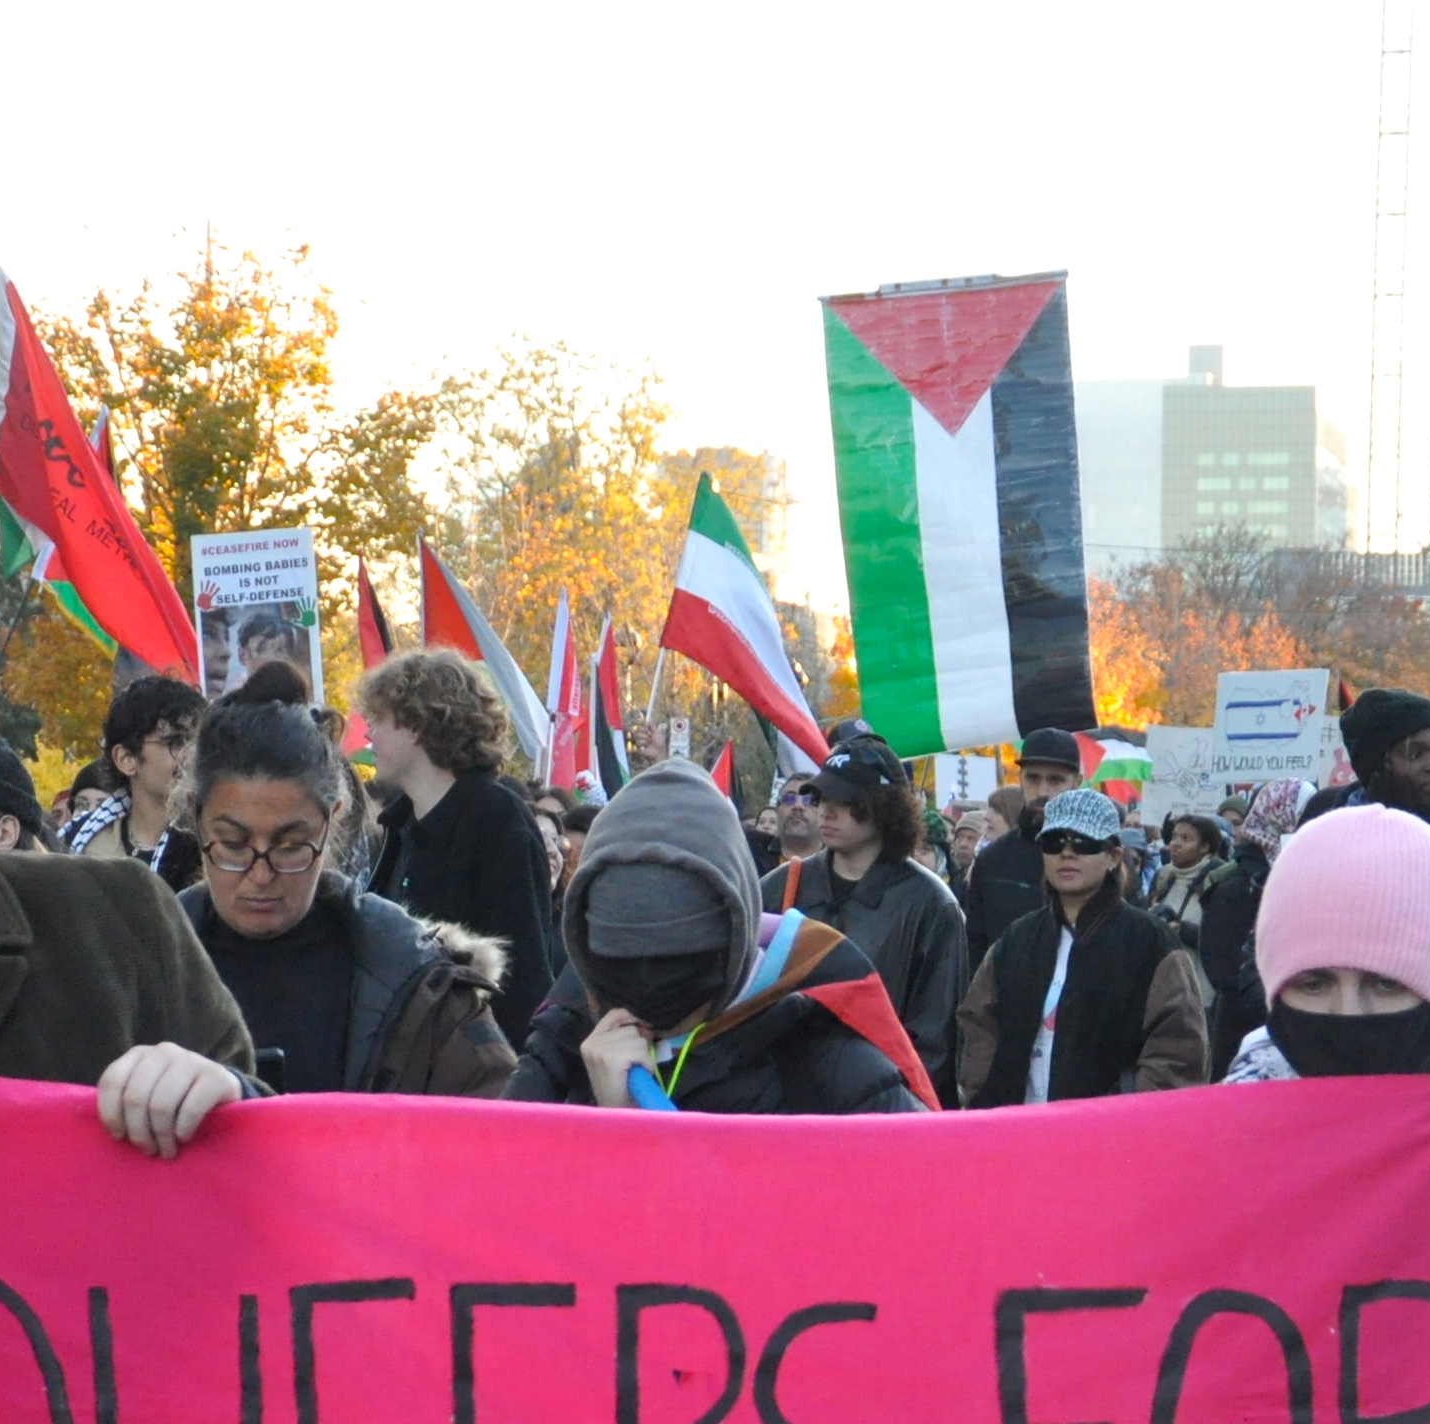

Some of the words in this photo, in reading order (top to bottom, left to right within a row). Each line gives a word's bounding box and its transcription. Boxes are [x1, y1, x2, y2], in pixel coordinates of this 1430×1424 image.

[201, 540, 270, 556] #CEASEFIRE
[273, 538, 299, 550] NOW
[204, 562, 262, 577] BOMBING
[265, 557, 309, 571] BABIES
[239, 577, 251, 588] IS
[254, 575, 279, 587] NOT
[216, 586, 305, 605] SELF-DEFENSE
[1210, 754, 1231, 774] HOW
[1233, 754, 1264, 771] WOULD
[1265, 754, 1284, 770] YOU
[1285, 754, 1313, 770] FEEL?
